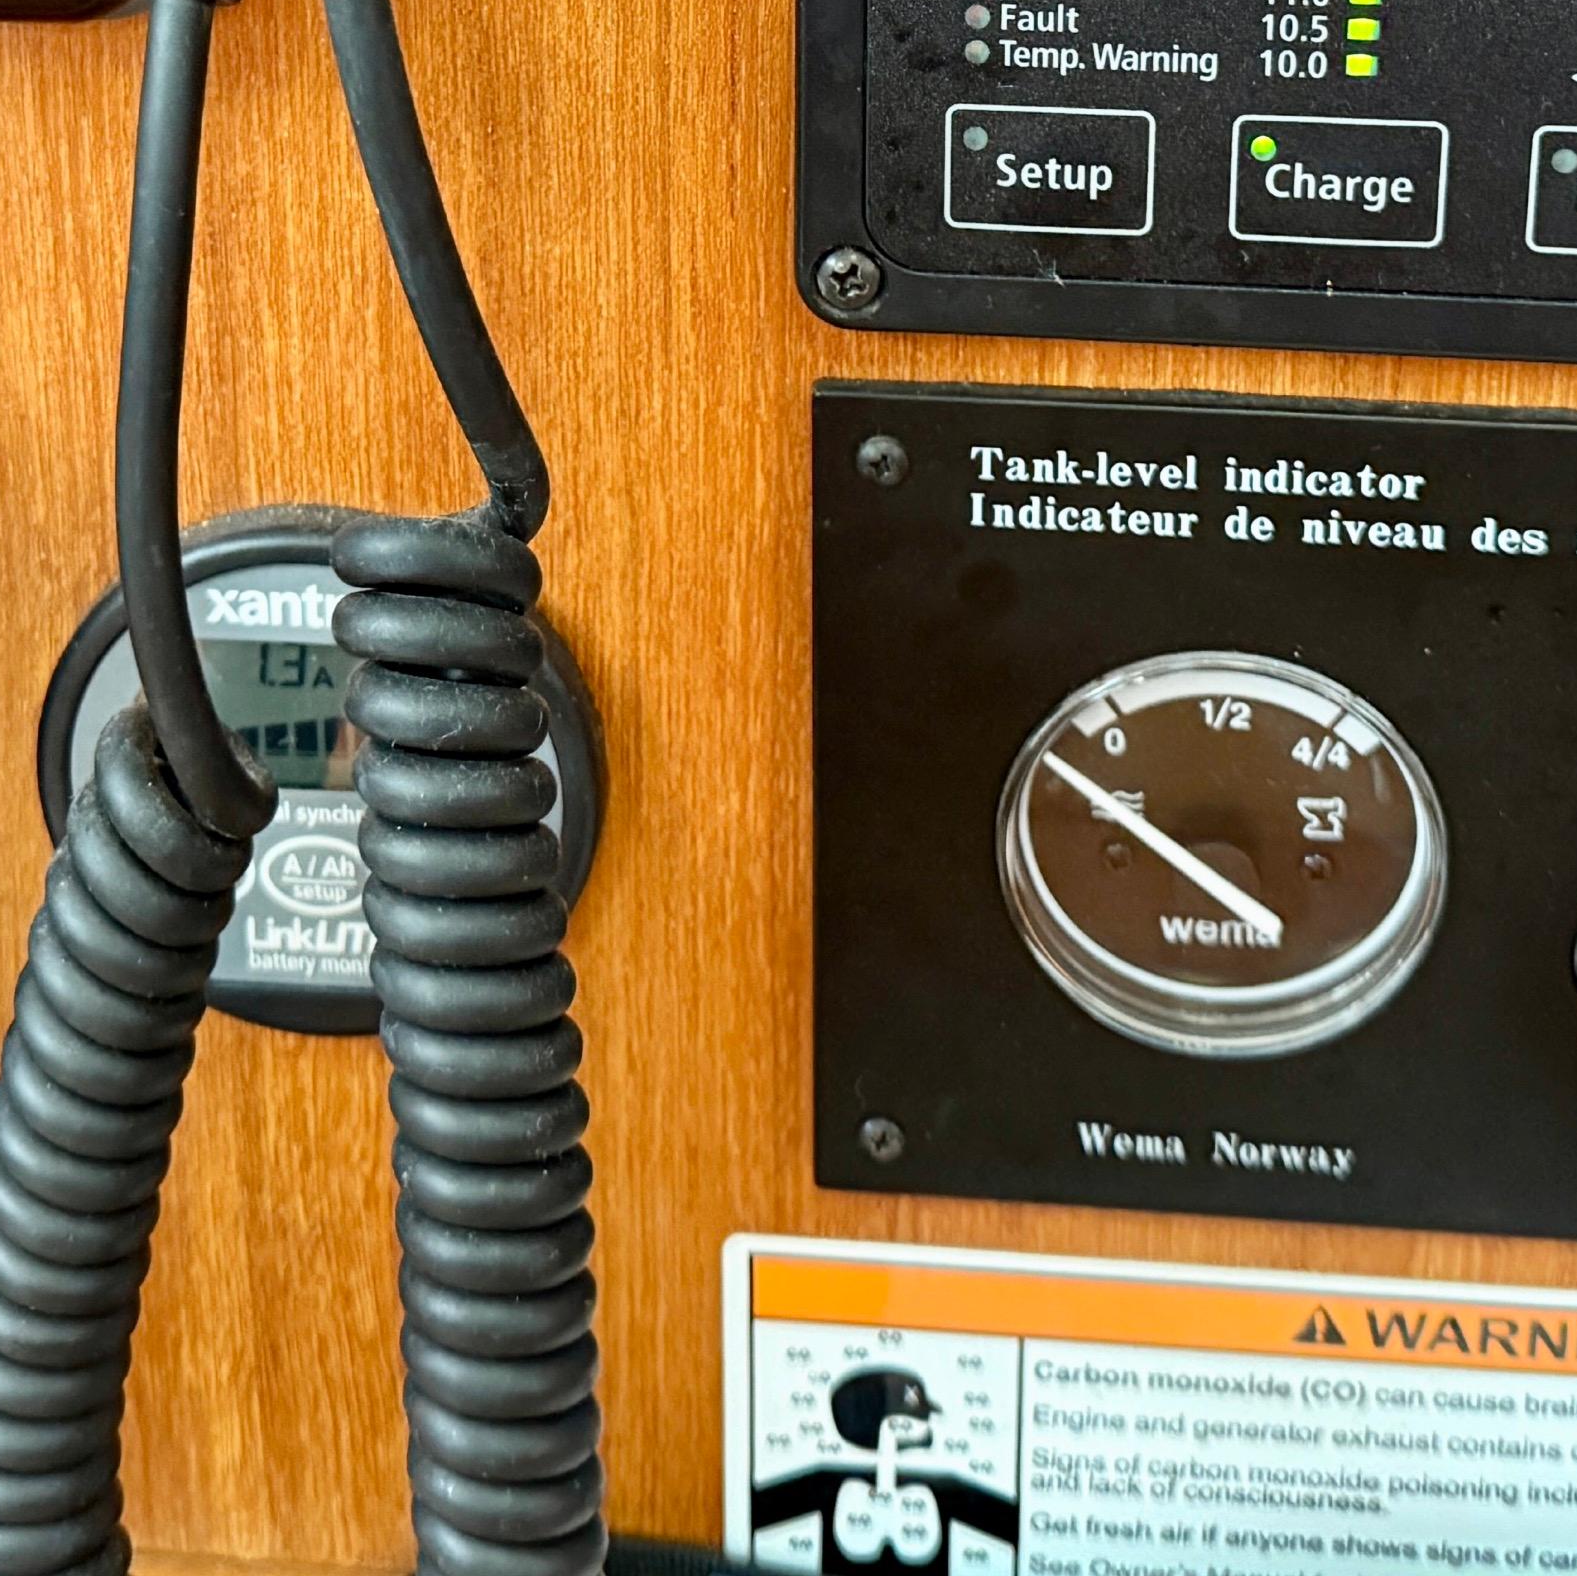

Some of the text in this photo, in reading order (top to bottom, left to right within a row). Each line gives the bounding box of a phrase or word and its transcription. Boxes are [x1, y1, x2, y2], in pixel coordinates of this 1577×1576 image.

[1000, 4, 1080, 33] Fault
[1261, 14, 1330, 43] 10.5
[999, 39, 1218, 82] Temp. Warning
[1259, 50, 1328, 79] 10.0
[996, 153, 1114, 201] Setup
[1264, 162, 1415, 213] Charge
[970, 446, 1425, 502] Tank-level indicator
[970, 494, 1198, 539] Indicateur
[1224, 506, 1276, 543] de
[1301, 510, 1446, 552] niveau
[1471, 516, 1550, 557] des
[206, 584, 346, 629] xantr
[1199, 697, 1252, 731] 1/2
[1103, 727, 1127, 756] 0
[1291, 737, 1350, 770] 4/4
[247, 916, 376, 954] LinkLIT
[249, 951, 316, 977] battery
[1211, 1130, 1356, 1182] Norway
[1034, 1360, 1138, 1387] Carbon
[1148, 1373, 1291, 1400] monoxide
[1300, 1378, 1367, 1406] (CO)
[1375, 1387, 1424, 1407] can
[1433, 1390, 1516, 1413] cause
